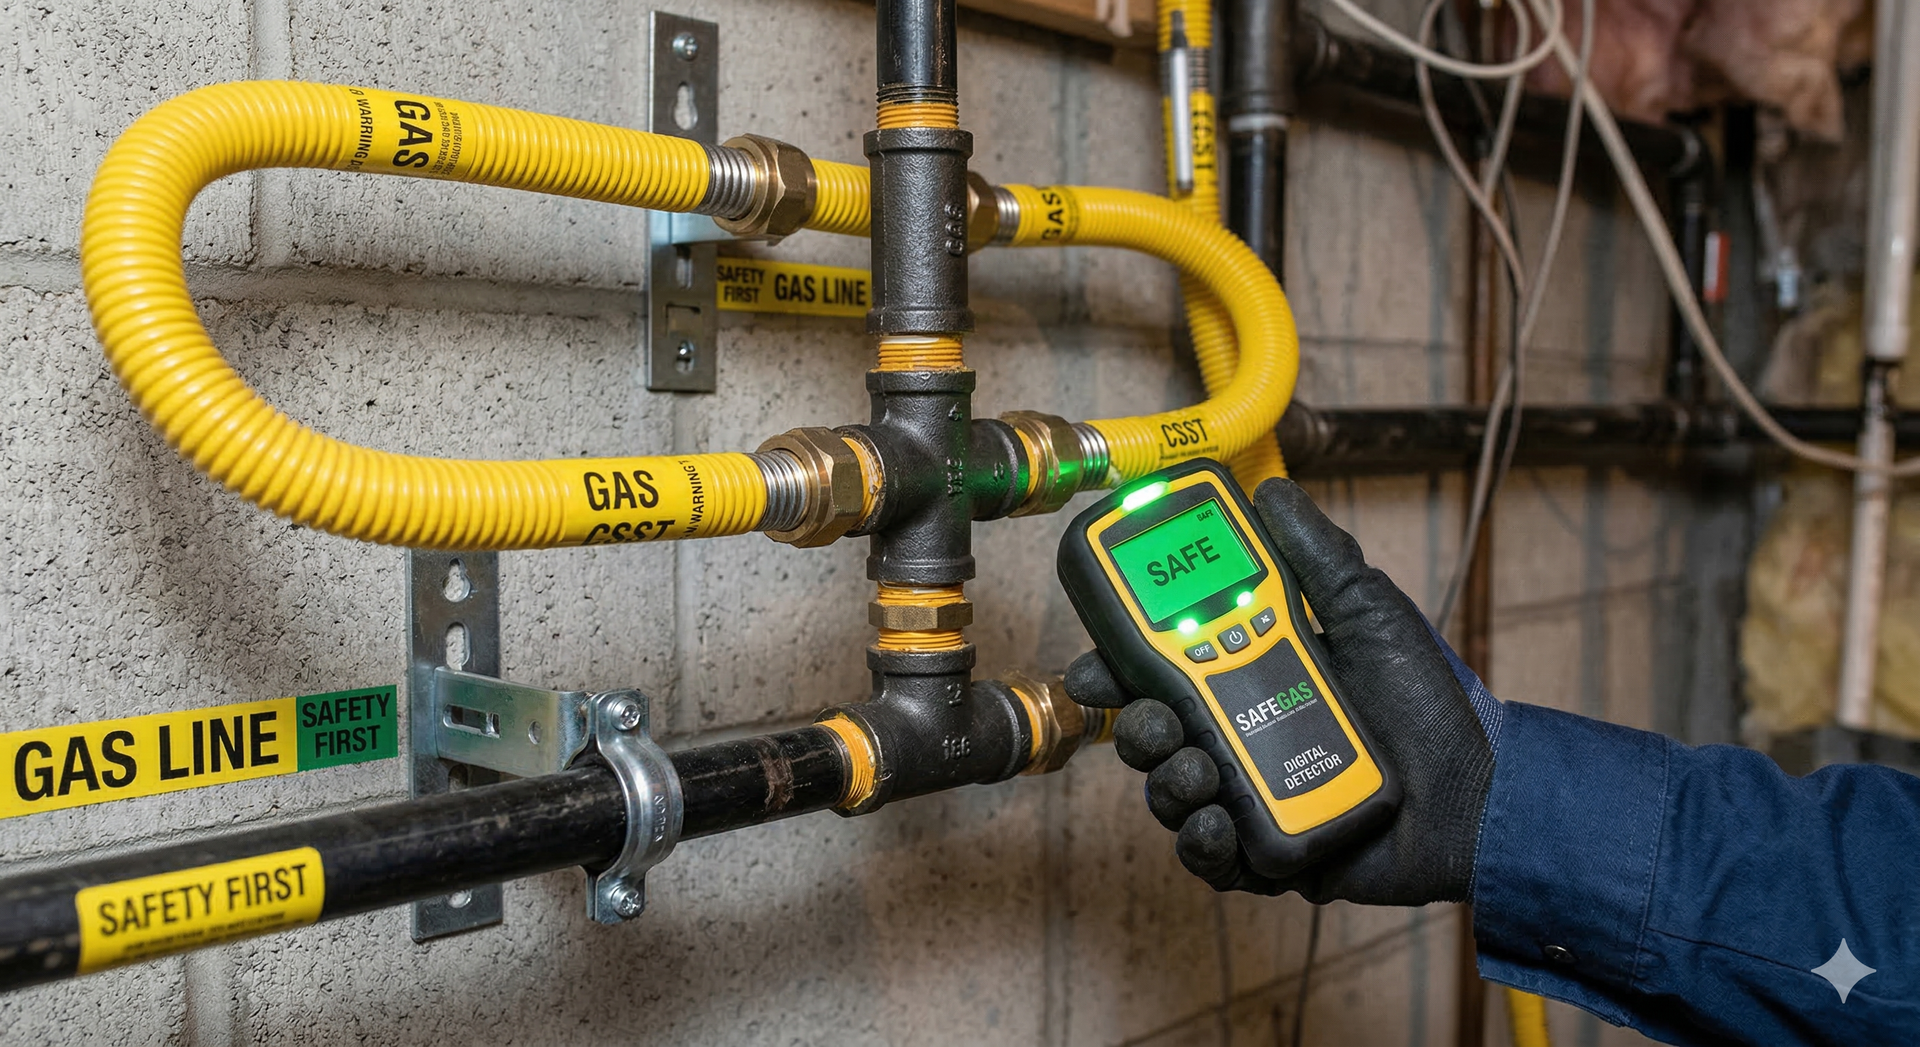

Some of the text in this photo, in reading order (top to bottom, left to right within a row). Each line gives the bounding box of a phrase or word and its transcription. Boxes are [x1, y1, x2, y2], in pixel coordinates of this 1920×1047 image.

[392, 100, 433, 168] GAS
[1041, 192, 1064, 241] GAS
[717, 265, 765, 285] SAFETY
[774, 273, 866, 307] GAS LINE
[724, 285, 761, 304] FIRST
[1161, 418, 1208, 448] CSST
[583, 470, 659, 511] GAS
[683, 465, 705, 528] WARNING
[1146, 536, 1221, 587] SAFE
[1194, 644, 1211, 658] OFF
[302, 692, 391, 729] SAFETY
[1235, 681, 1314, 732] SAFEGAS
[14, 711, 279, 802] GAS LINE
[314, 724, 381, 759] FIRST
[1283, 744, 1328, 774] DIGITAL
[1283, 753, 1343, 791] DETECTOR
[97, 863, 307, 937] SAFETY FIRST
